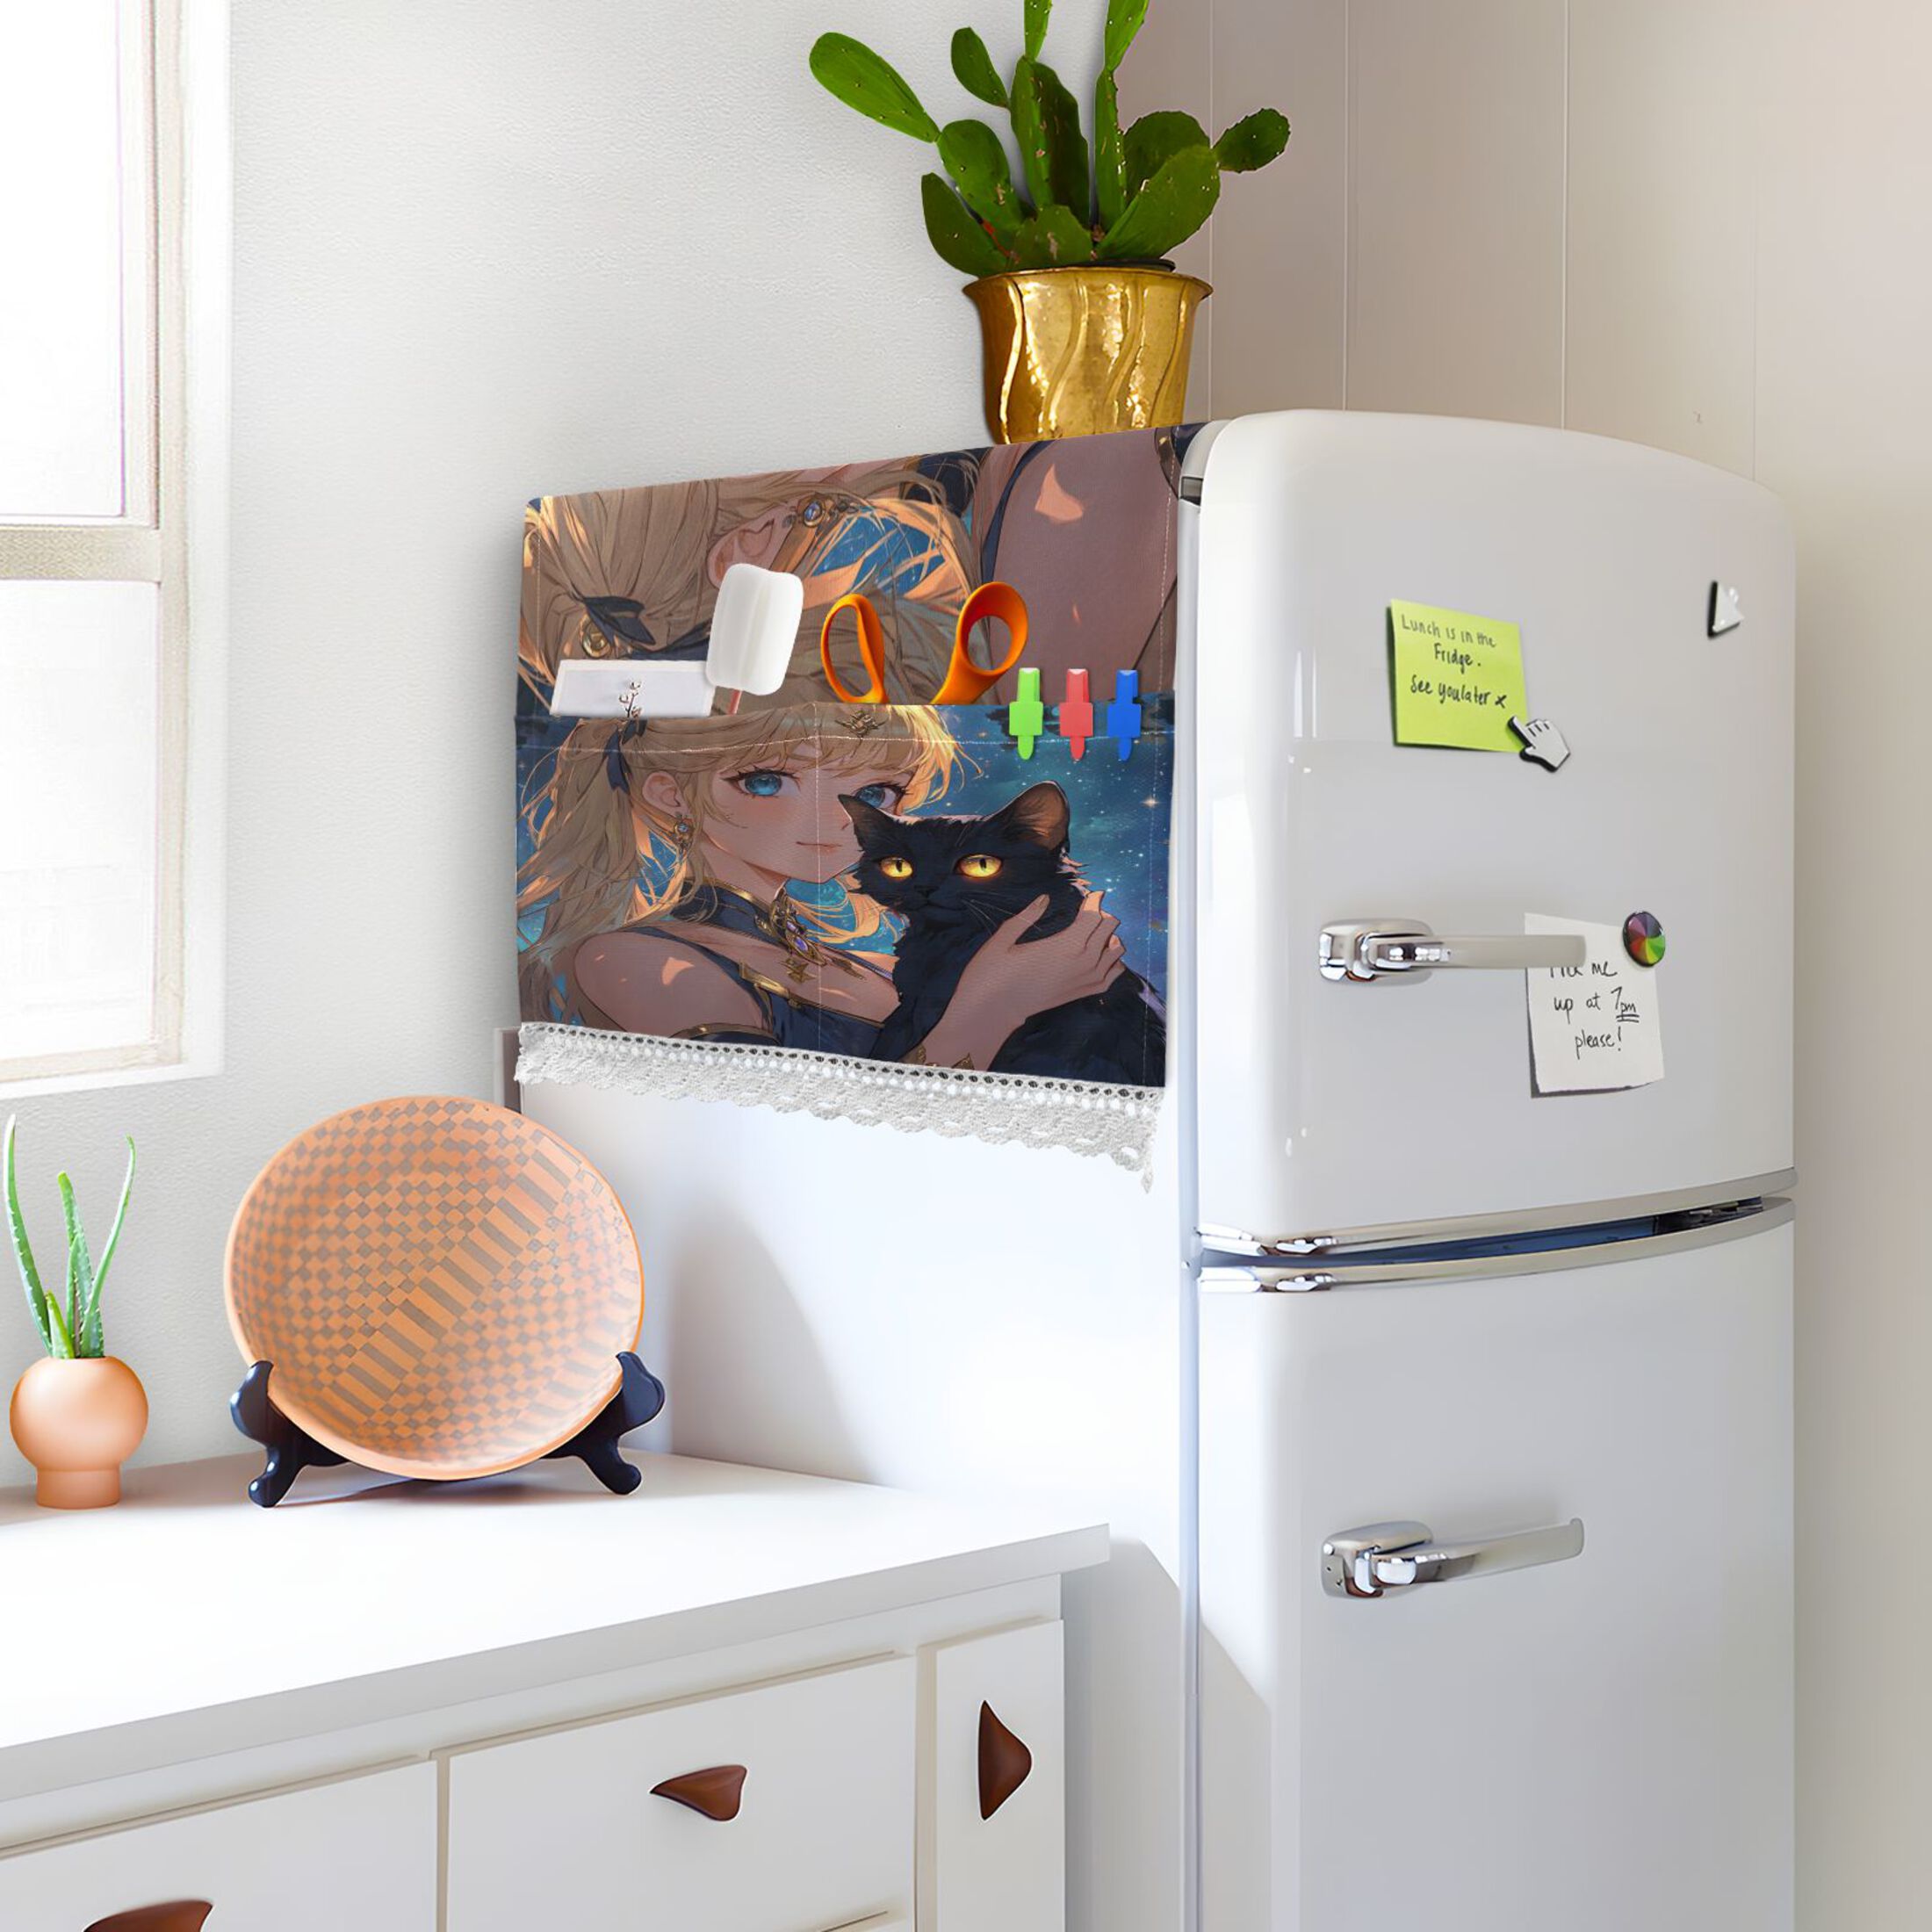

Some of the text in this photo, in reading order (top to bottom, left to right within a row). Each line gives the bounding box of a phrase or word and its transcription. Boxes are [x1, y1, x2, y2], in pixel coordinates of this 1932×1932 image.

[1401, 613, 1496, 647] Lunch is in the
[1409, 674, 1433, 694] See
[1554, 996, 1574, 1024] up
[1586, 992, 1601, 1010] at
[1575, 1026, 1622, 1060] please!
